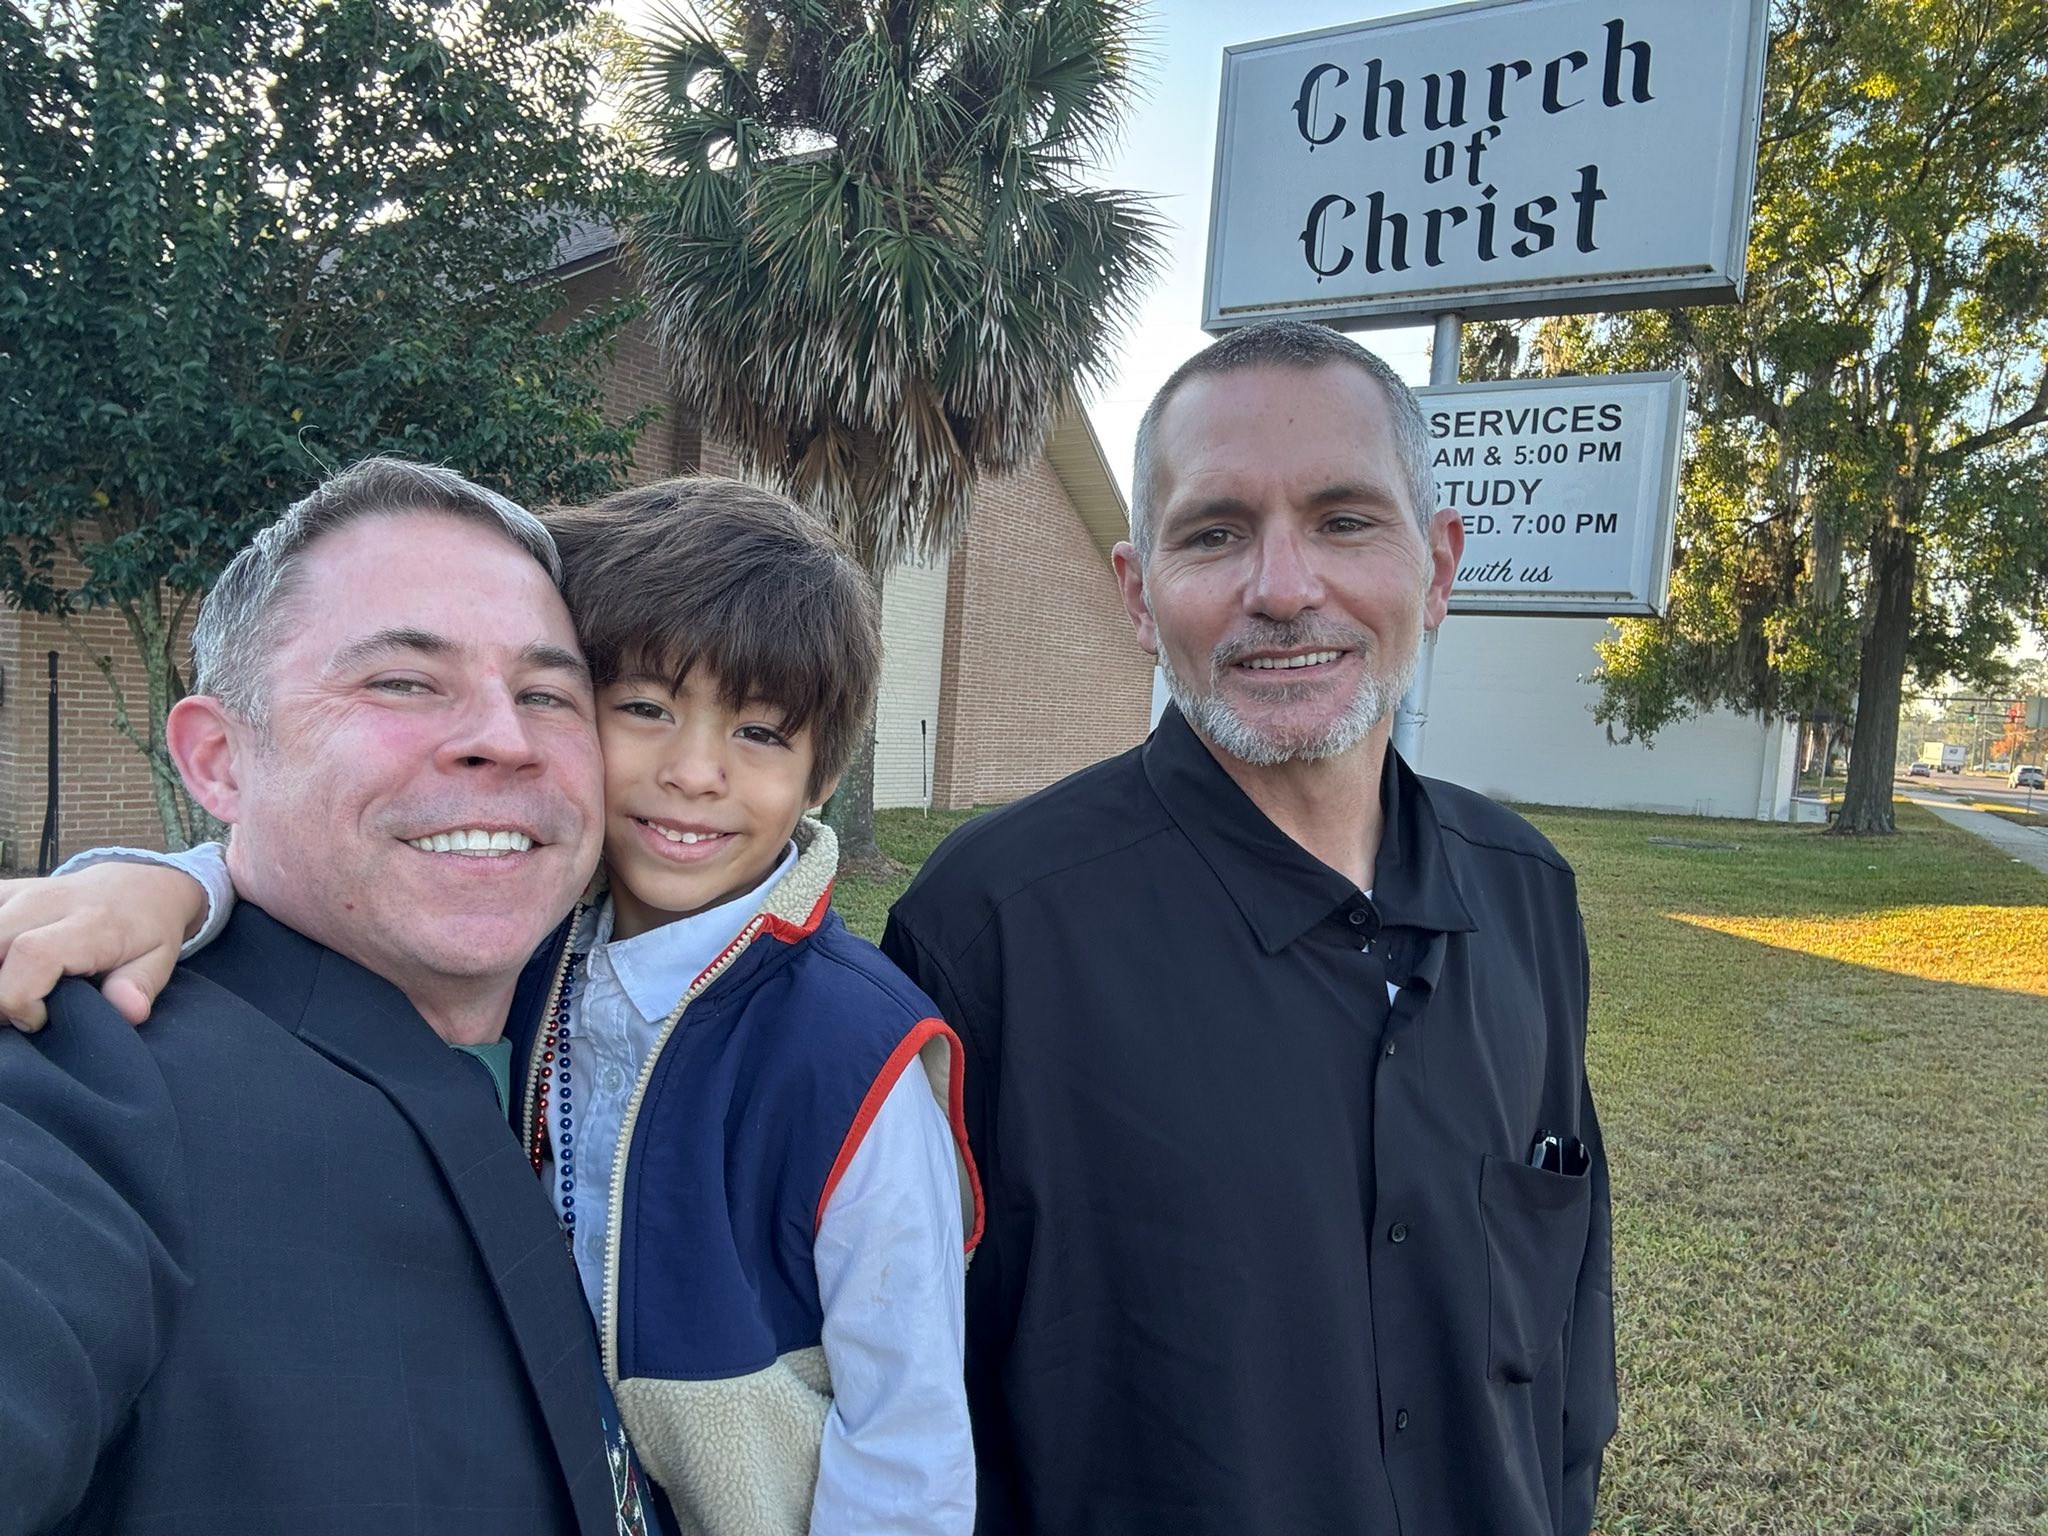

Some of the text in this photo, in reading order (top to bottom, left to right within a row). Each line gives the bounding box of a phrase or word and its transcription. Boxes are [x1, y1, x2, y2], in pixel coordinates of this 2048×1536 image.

[1291, 18, 1656, 153] Church
[1424, 125, 1501, 186] of
[1298, 164, 1608, 284] Christ
[1430, 403, 1623, 439] SERVICES
[1432, 441, 1623, 468] AM & 5:00 PM
[1435, 478, 1543, 507] TUDY
[1461, 513, 1618, 535] ED. 7:00 PM
[1457, 557, 1553, 583] with us
